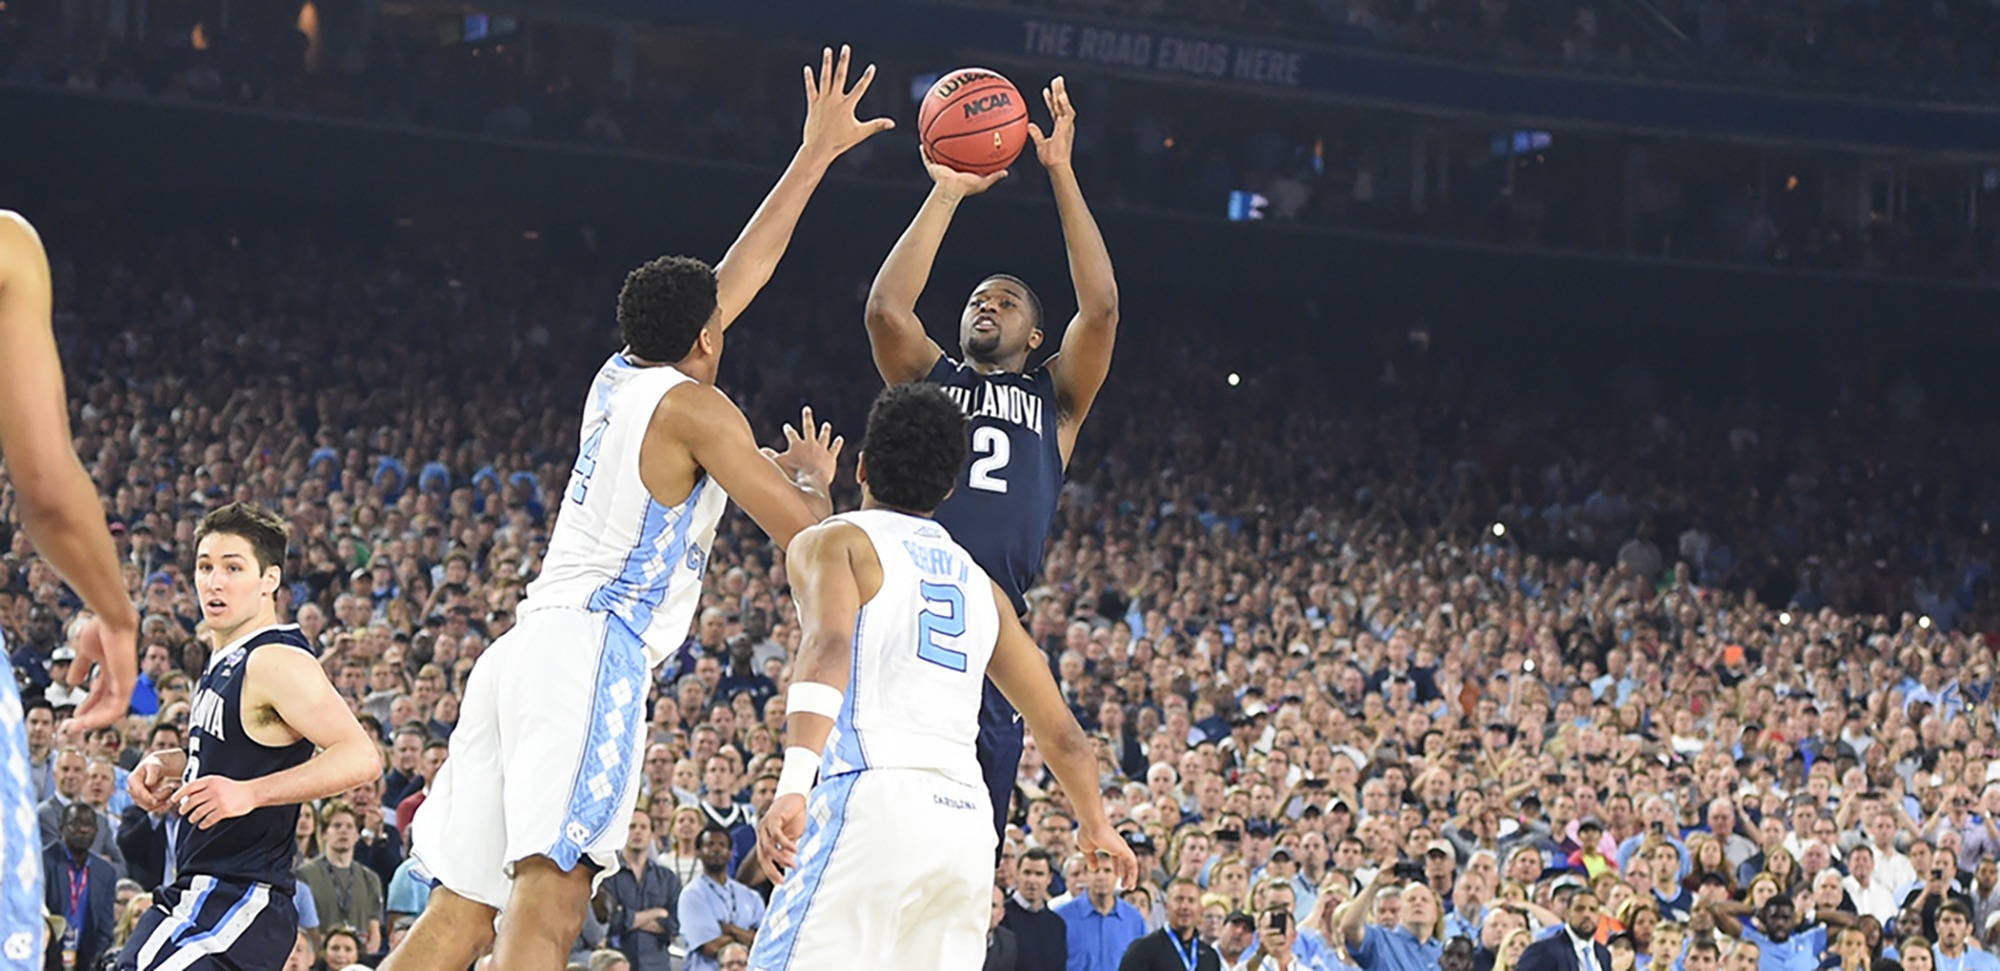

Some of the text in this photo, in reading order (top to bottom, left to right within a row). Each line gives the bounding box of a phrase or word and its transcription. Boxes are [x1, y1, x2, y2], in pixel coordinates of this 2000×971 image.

[1023, 21, 1301, 85] THE ROAD ENDS HERE
[962, 92, 1012, 119] NCAA
[968, 425, 1011, 494] 2
[916, 578, 968, 674] 2
[933, 793, 977, 811] CAROLINA
